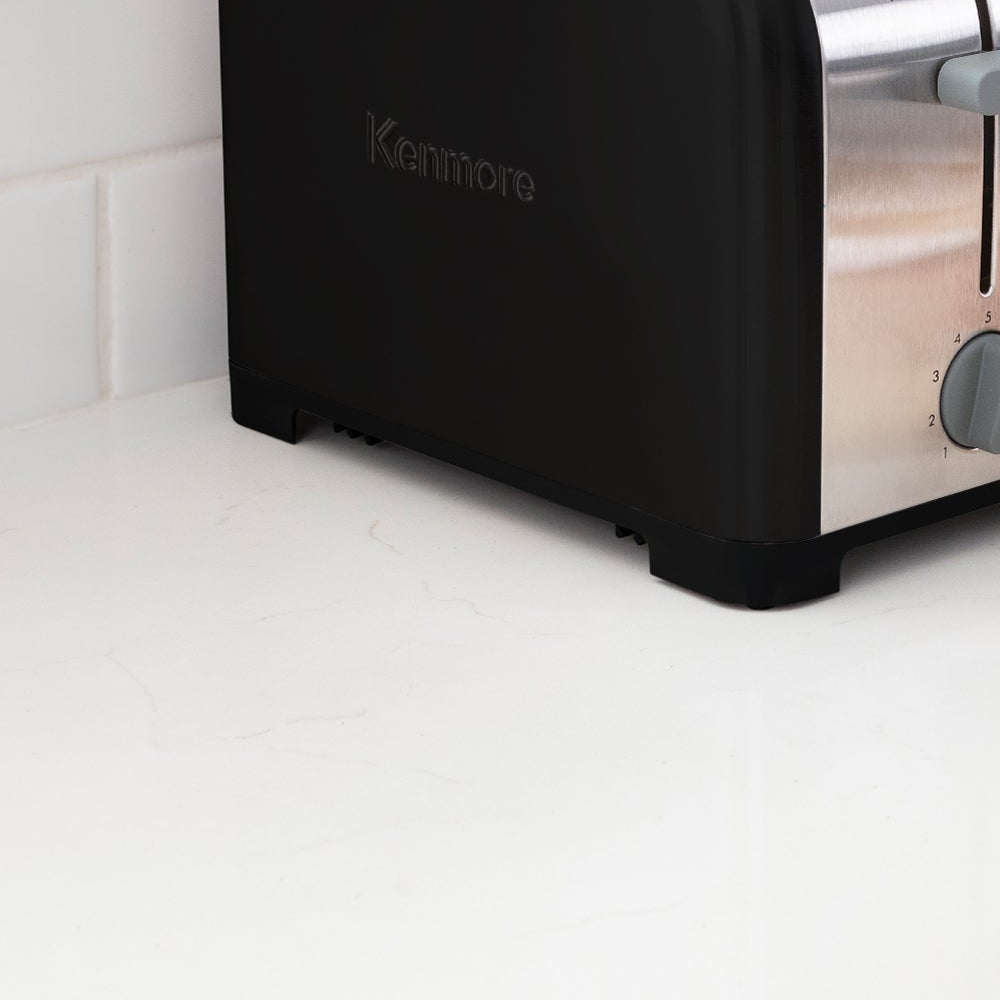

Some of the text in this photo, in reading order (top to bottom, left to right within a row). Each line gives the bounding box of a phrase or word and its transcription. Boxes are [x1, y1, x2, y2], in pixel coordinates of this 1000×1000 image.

[366, 111, 536, 202] Kenmore
[984, 311, 992, 323] 5
[954, 333, 961, 344] 4
[932, 370, 940, 382] 3
[928, 414, 935, 427] 2
